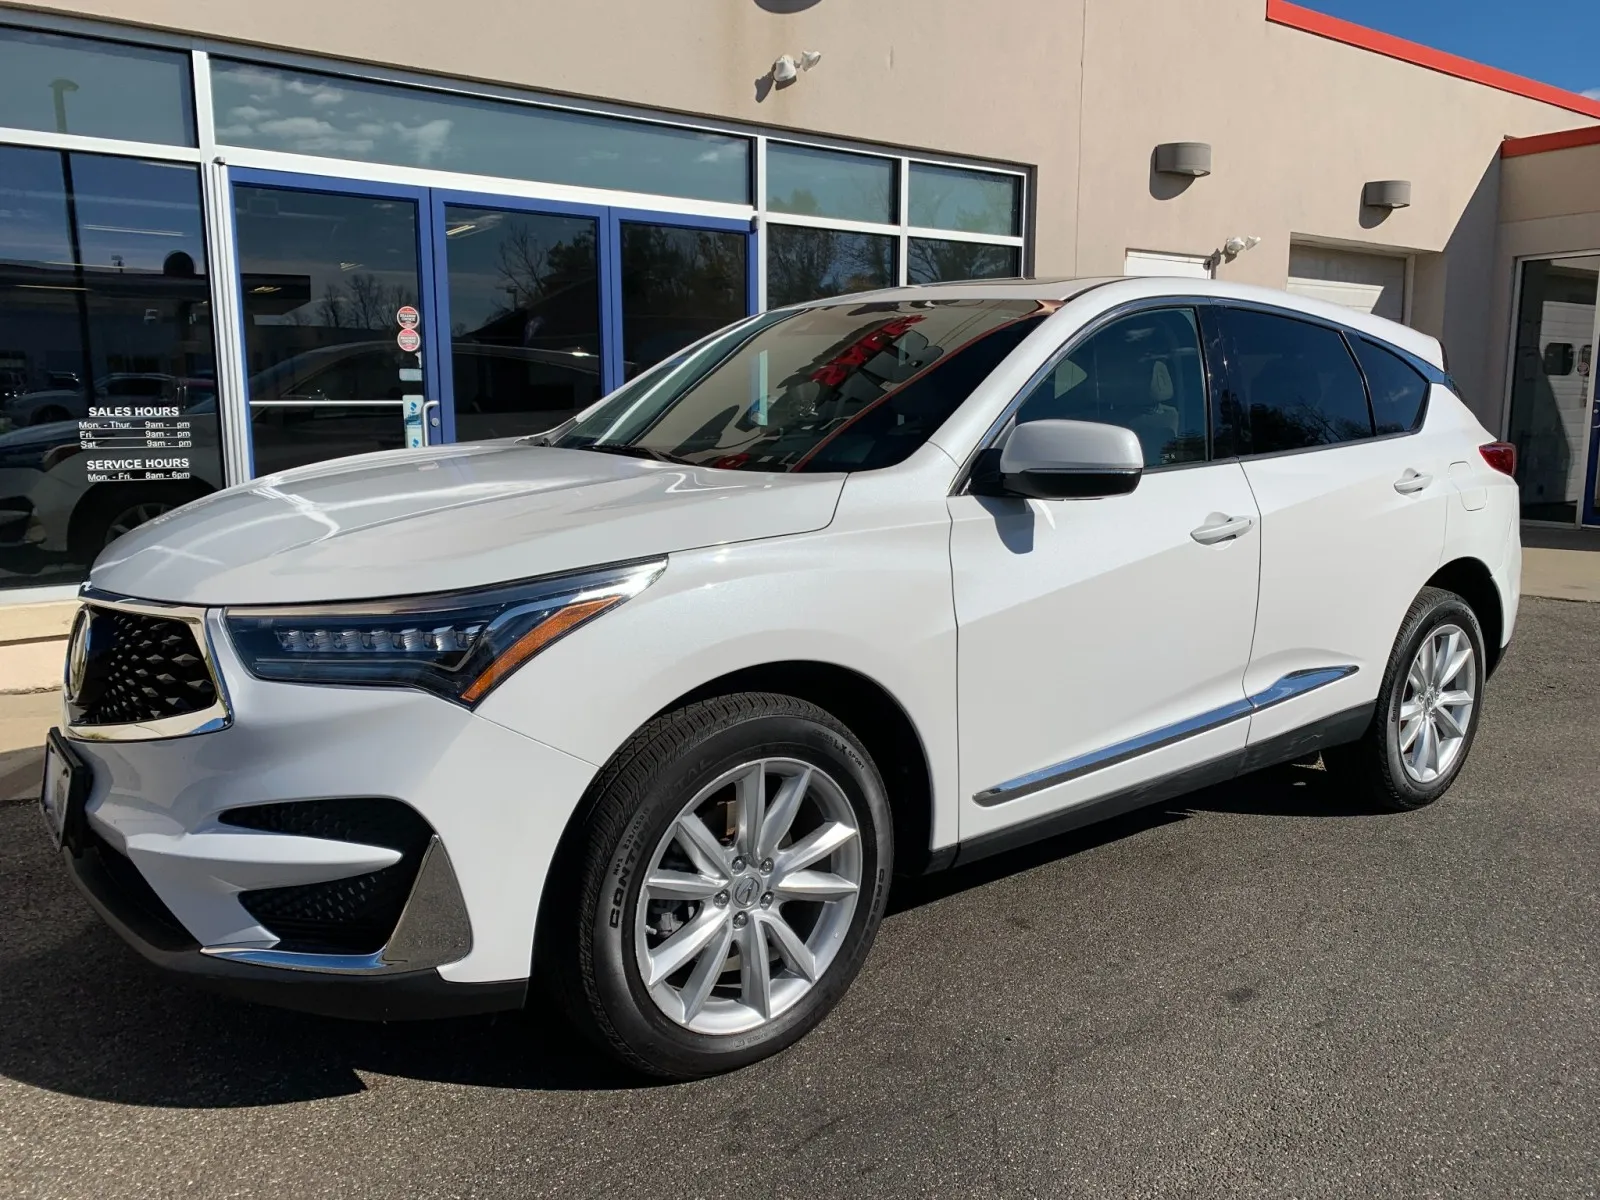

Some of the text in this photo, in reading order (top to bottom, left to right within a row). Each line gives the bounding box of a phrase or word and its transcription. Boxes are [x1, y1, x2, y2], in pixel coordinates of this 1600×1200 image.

[88, 406, 179, 417] SALES HOURS
[78, 421, 101, 429] Mon.
[109, 420, 133, 429] Thur.
[144, 420, 165, 429] 9am
[79, 431, 95, 439] Fri.
[144, 430, 165, 438] 9am
[80, 440, 99, 449] Sat.
[146, 440, 166, 448] 9am
[86, 458, 189, 470] SERVICE HOURS
[87, 473, 110, 481] Mon.
[118, 473, 133, 481] Fri.
[145, 472, 165, 480] 8am
[171, 471, 191, 480] 6pm
[832, 739, 848, 756] LX
[848, 750, 865, 770] SPORT
